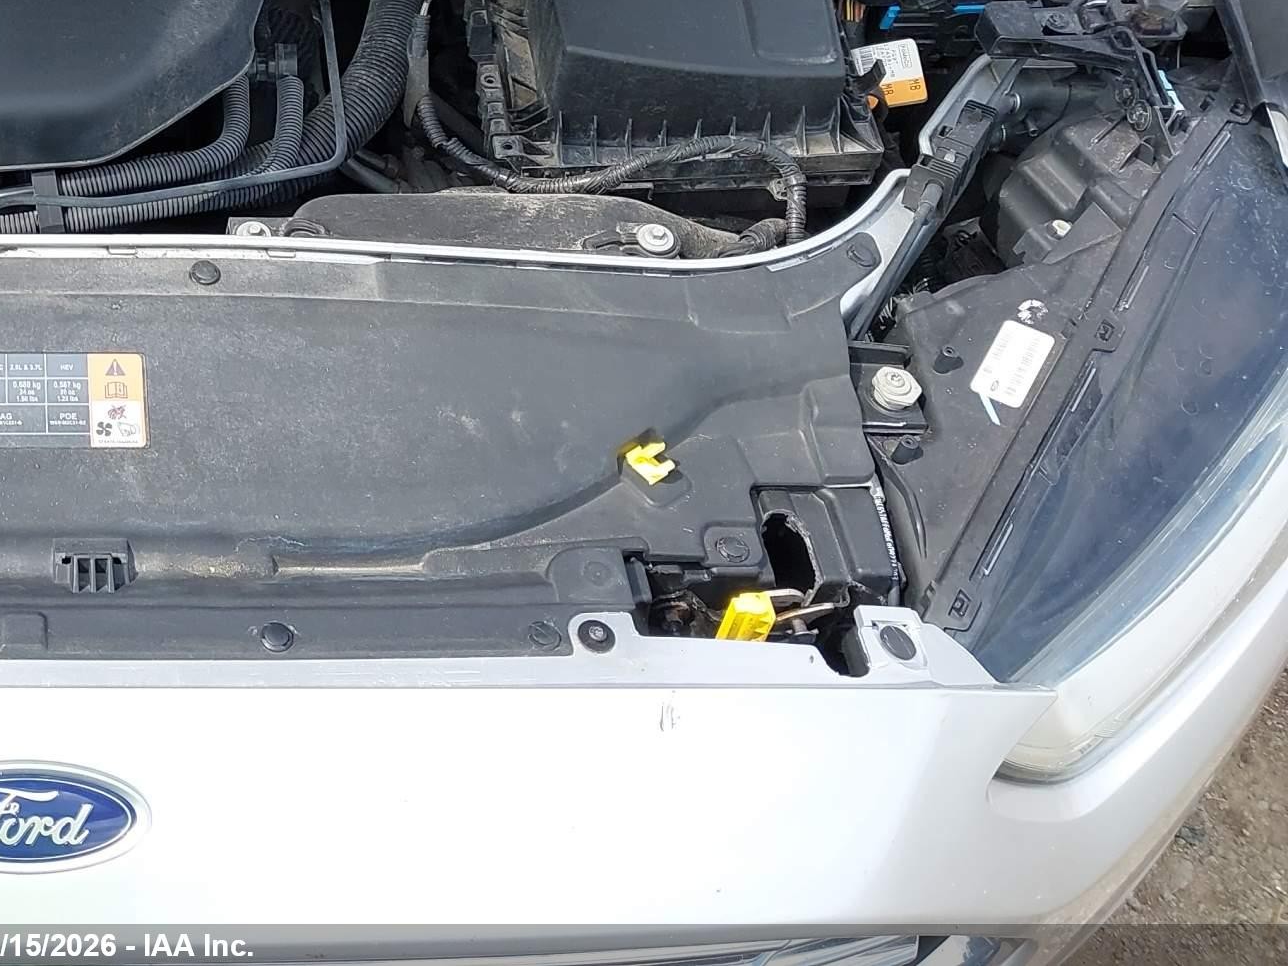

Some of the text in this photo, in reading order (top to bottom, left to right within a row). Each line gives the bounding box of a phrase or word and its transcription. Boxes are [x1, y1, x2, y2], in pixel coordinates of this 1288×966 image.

[909, 79, 921, 91] MB
[32, 381, 41, 390] kg
[72, 381, 81, 390] kg
[59, 412, 77, 420] POE
